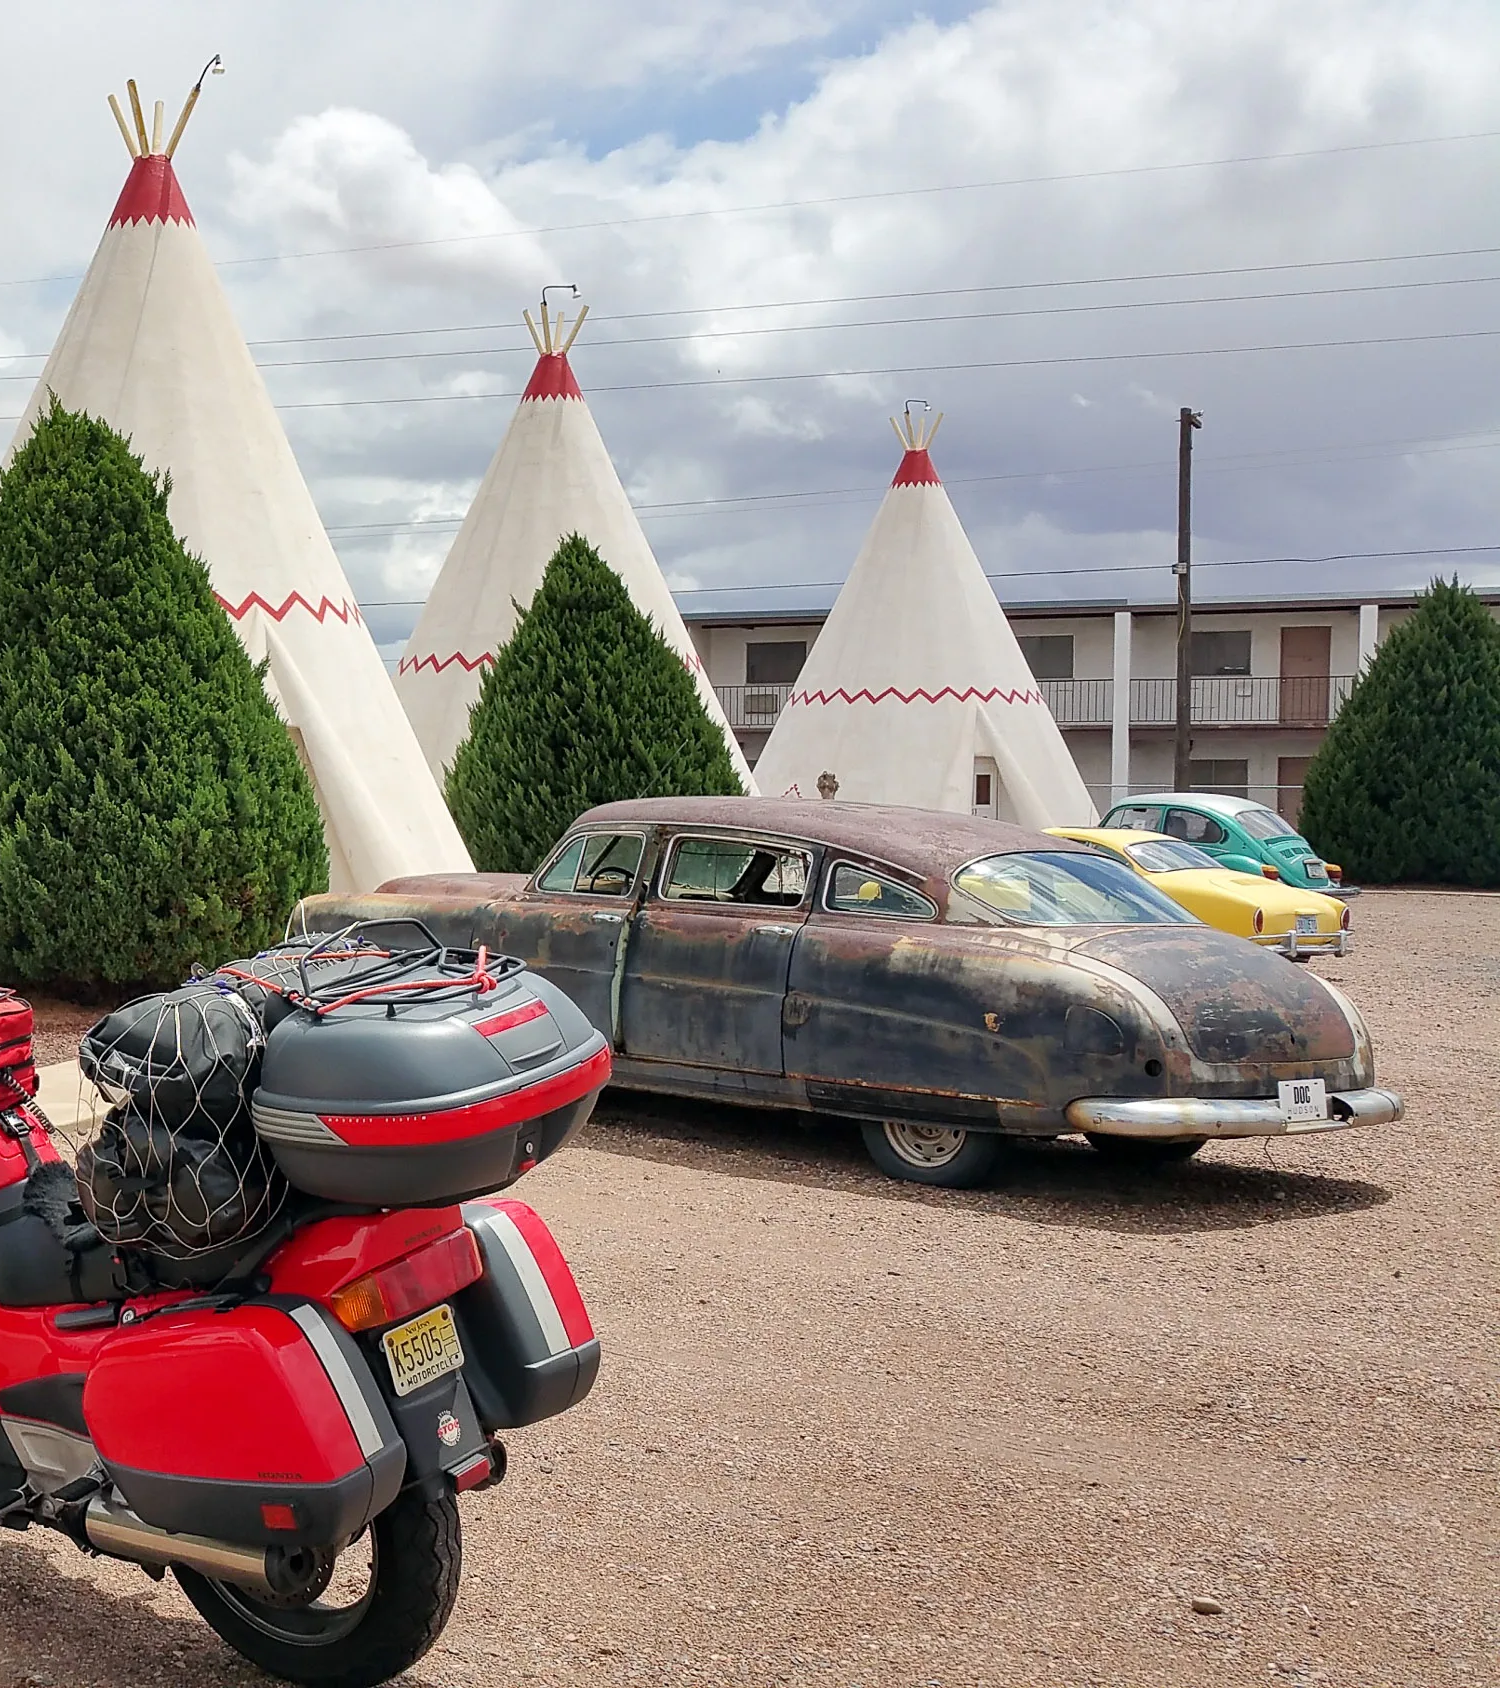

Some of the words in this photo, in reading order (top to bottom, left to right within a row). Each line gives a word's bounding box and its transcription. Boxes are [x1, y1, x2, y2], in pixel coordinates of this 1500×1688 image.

[1293, 1085, 1311, 1105] DOC
[1287, 1106, 1319, 1115] HUDSON
[391, 1326, 442, 1377] K5505
[407, 1358, 453, 1386] MOTORCYCLE
